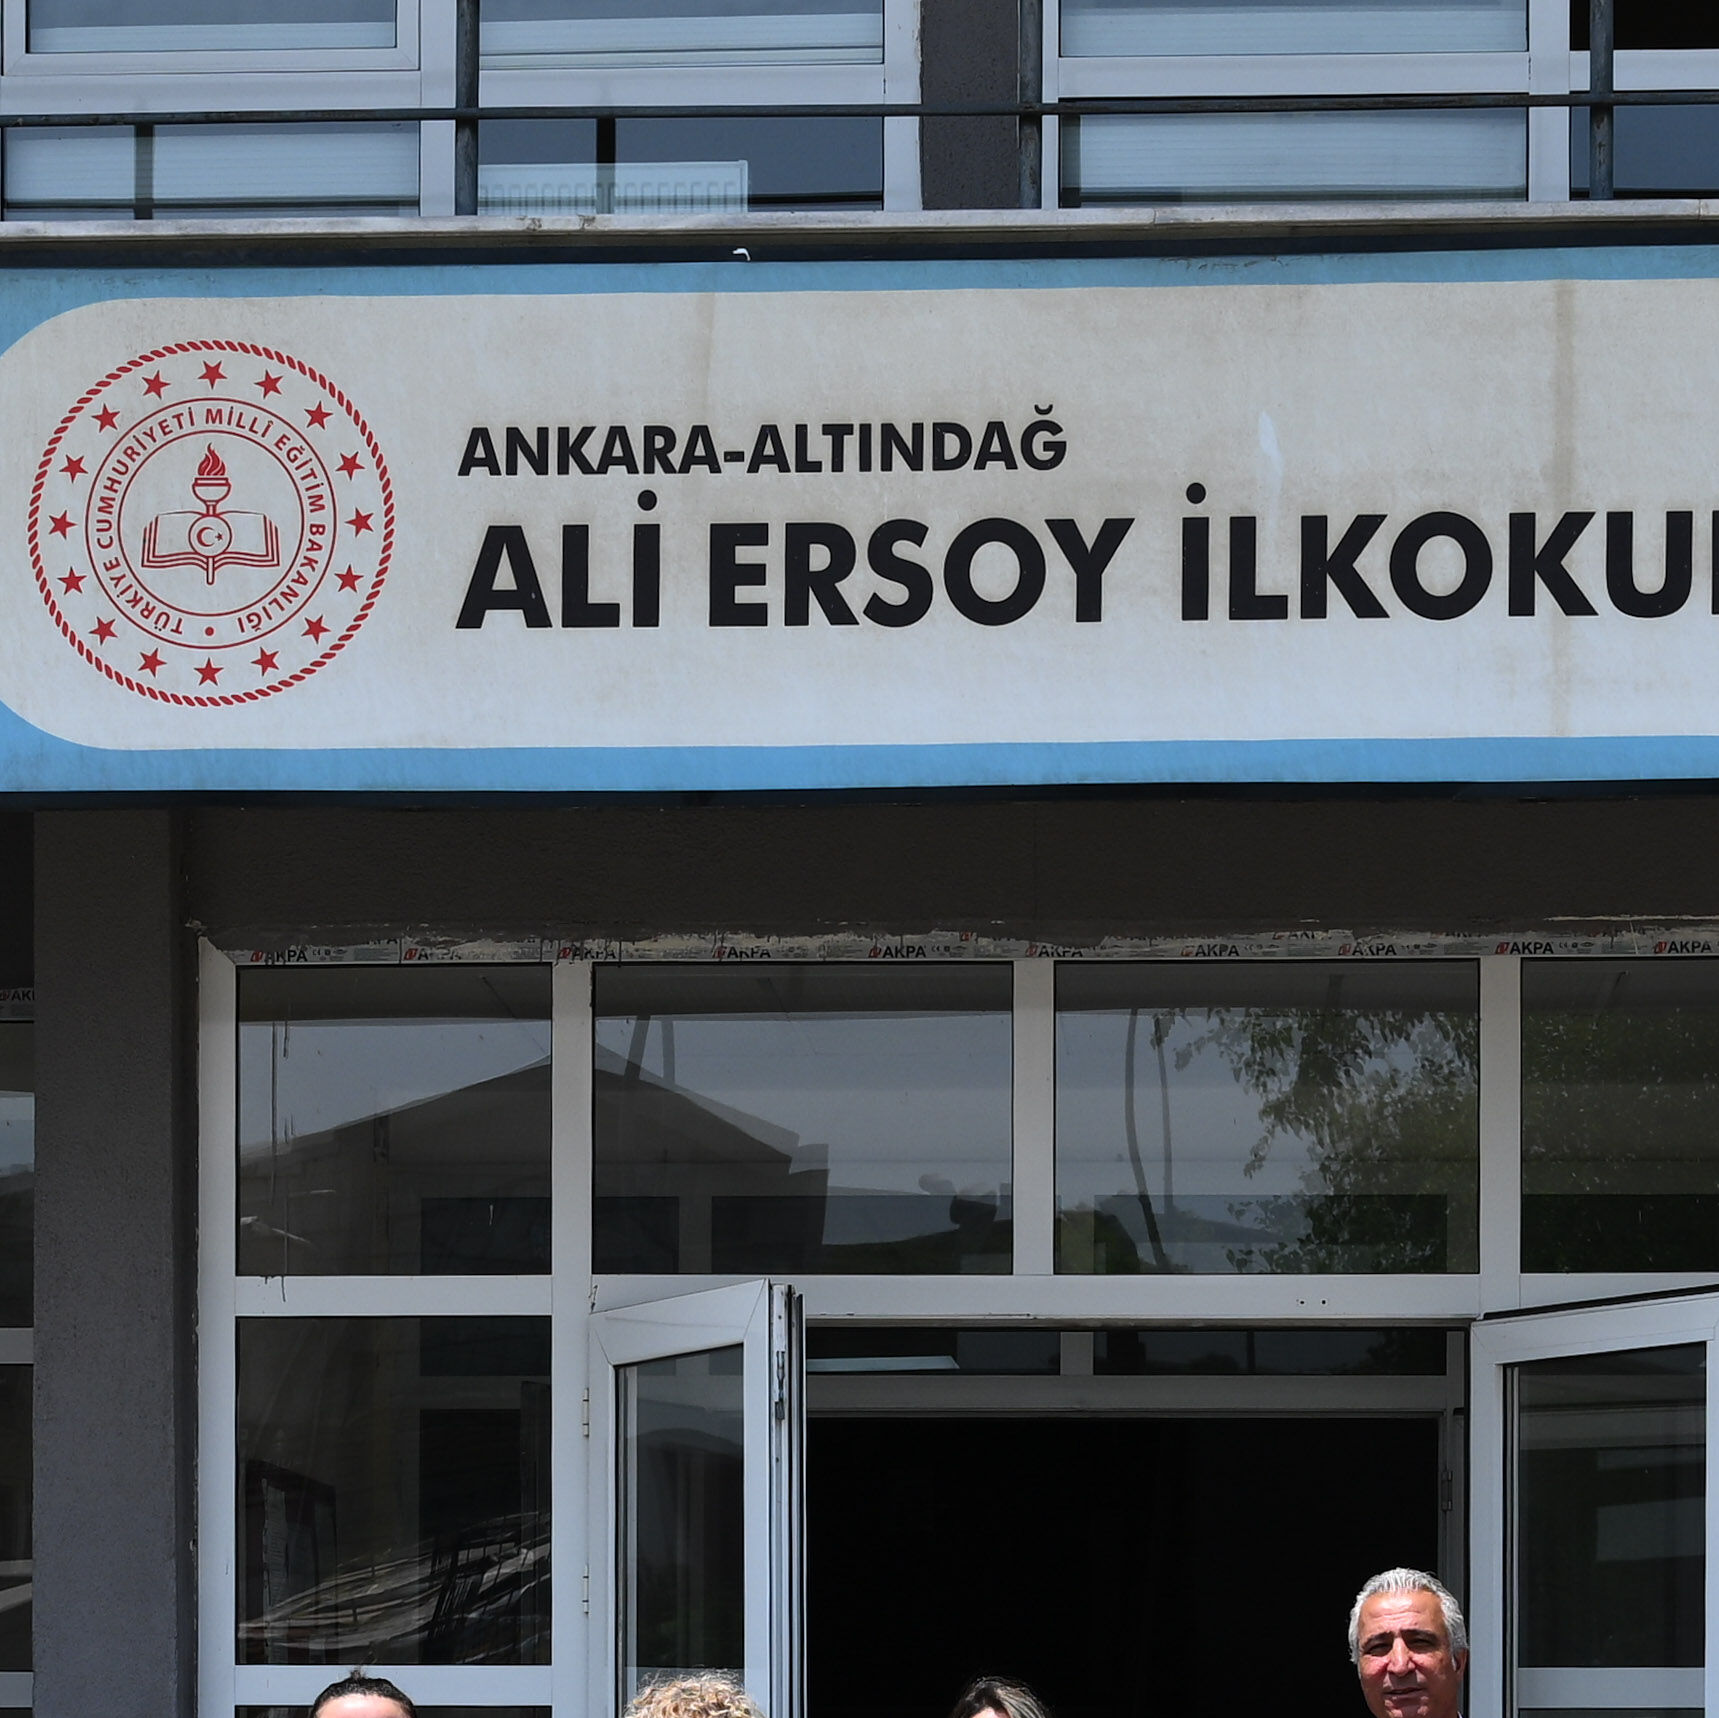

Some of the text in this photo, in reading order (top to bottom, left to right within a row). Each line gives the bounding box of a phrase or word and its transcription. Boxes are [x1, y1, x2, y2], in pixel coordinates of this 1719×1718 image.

[96, 407, 195, 549] CUMHURİYETİ
[274, 433, 326, 513] EĞİTİM
[457, 404, 1067, 477] ANKARA-ALTINDAĞ
[103, 557, 183, 635] TÜRKİYE
[237, 523, 326, 633] BAKANLIĞI
[455, 488, 661, 629] ALİ
[708, 517, 1136, 628] ERSOY
[882, 946, 927, 958] AKPA
[1510, 942, 1554, 955] AKPA
[1667, 940, 1712, 953] AKPA
